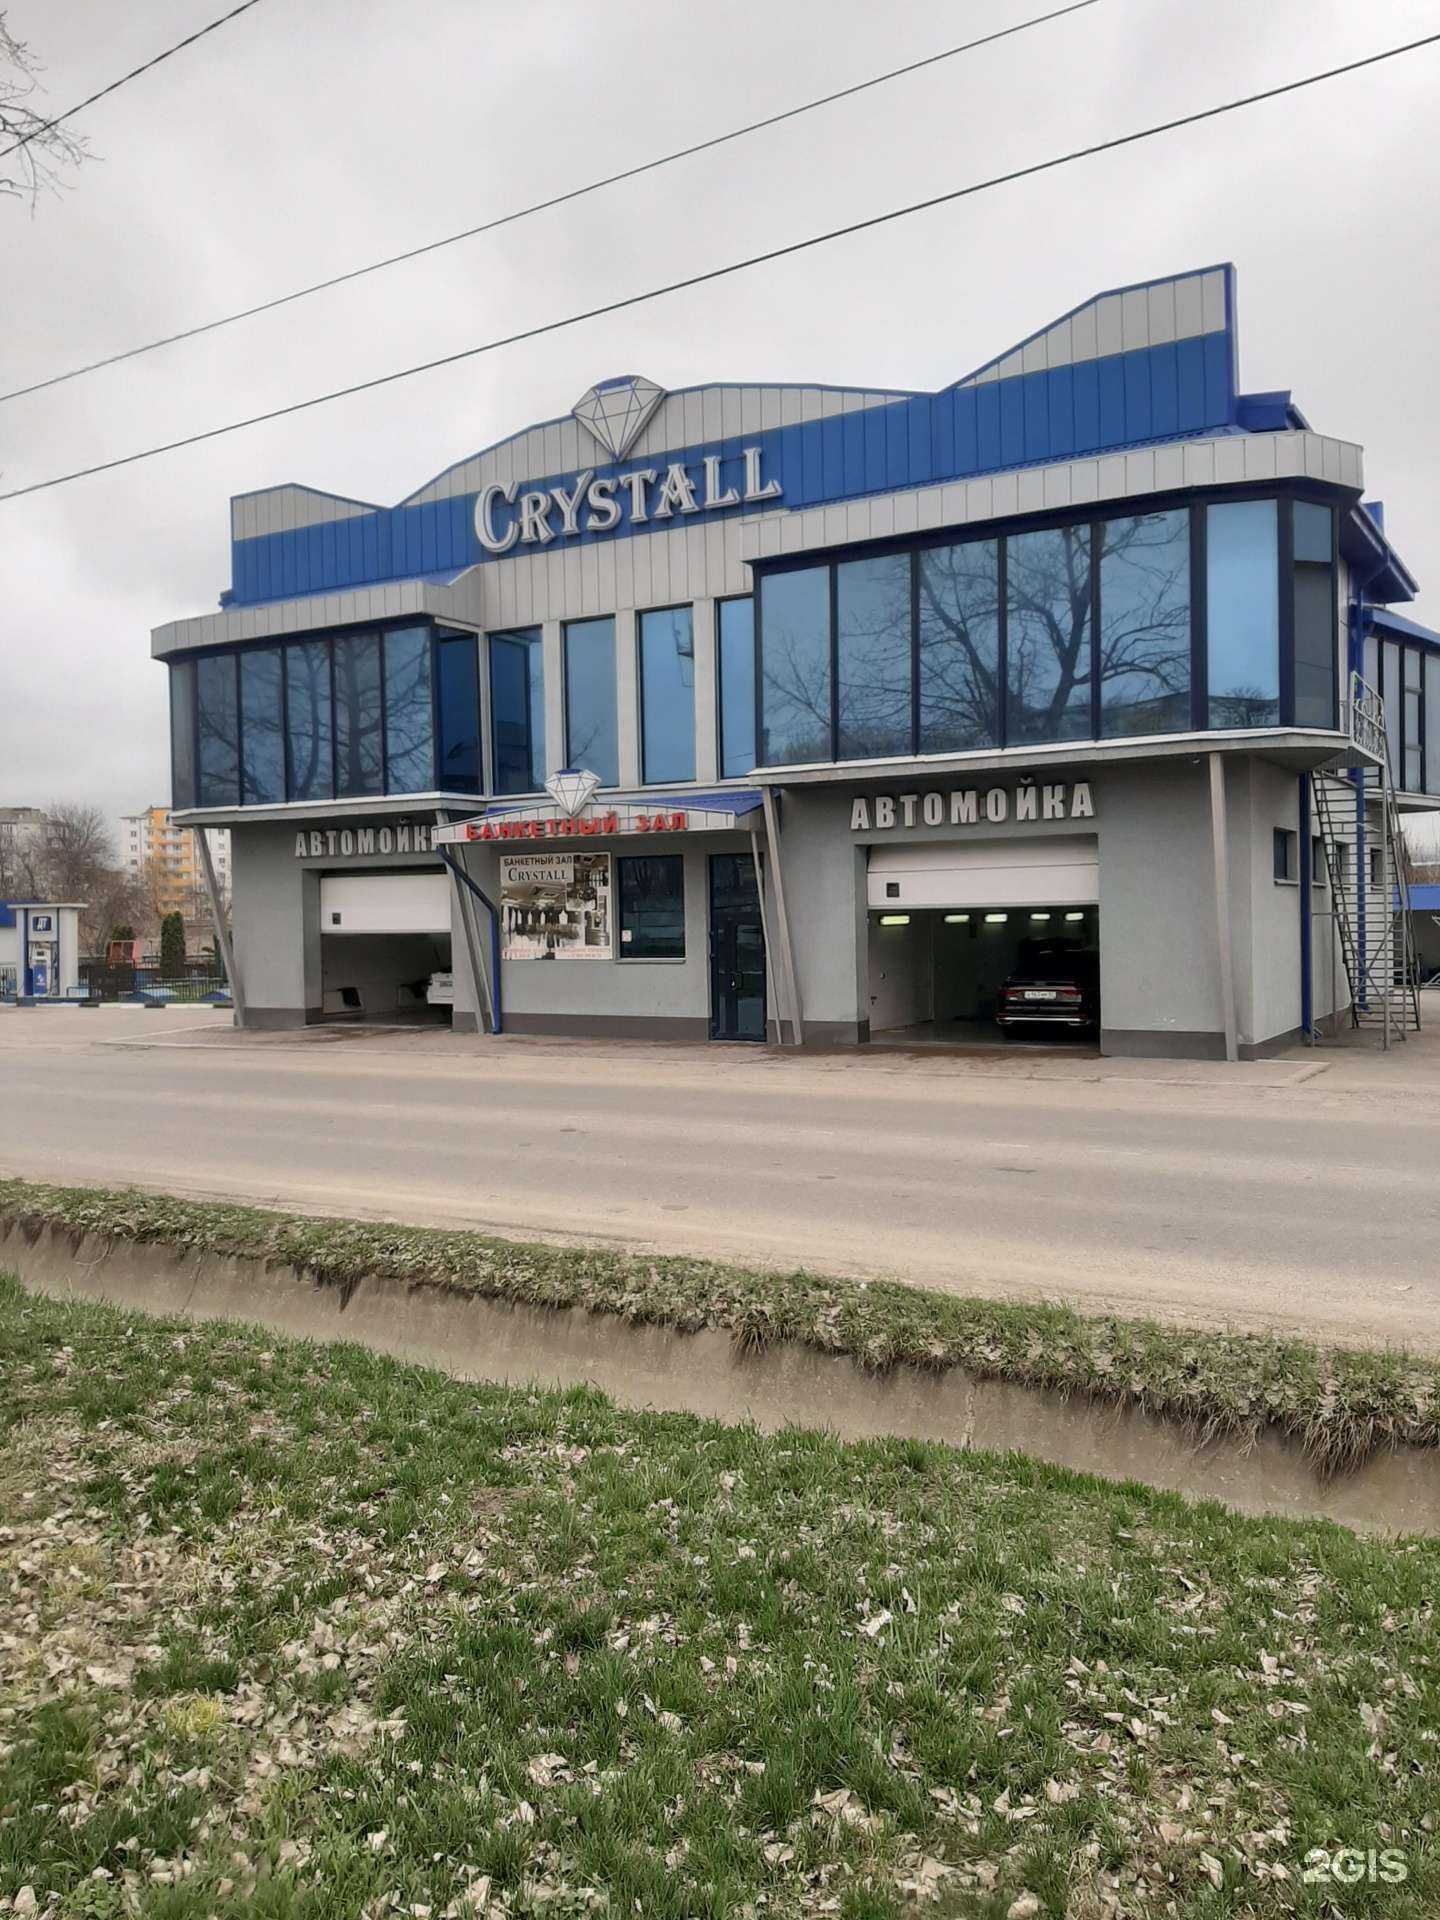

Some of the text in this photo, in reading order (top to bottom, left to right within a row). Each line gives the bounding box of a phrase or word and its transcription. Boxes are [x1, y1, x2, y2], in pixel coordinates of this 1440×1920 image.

[850, 776, 1095, 830] АВТОМОЙКА
[464, 810, 688, 840] БАНКЕТНЫЙ ЗАЛ
[504, 856, 573, 867] БАНКЕТНЫЙ ЗАЛ
